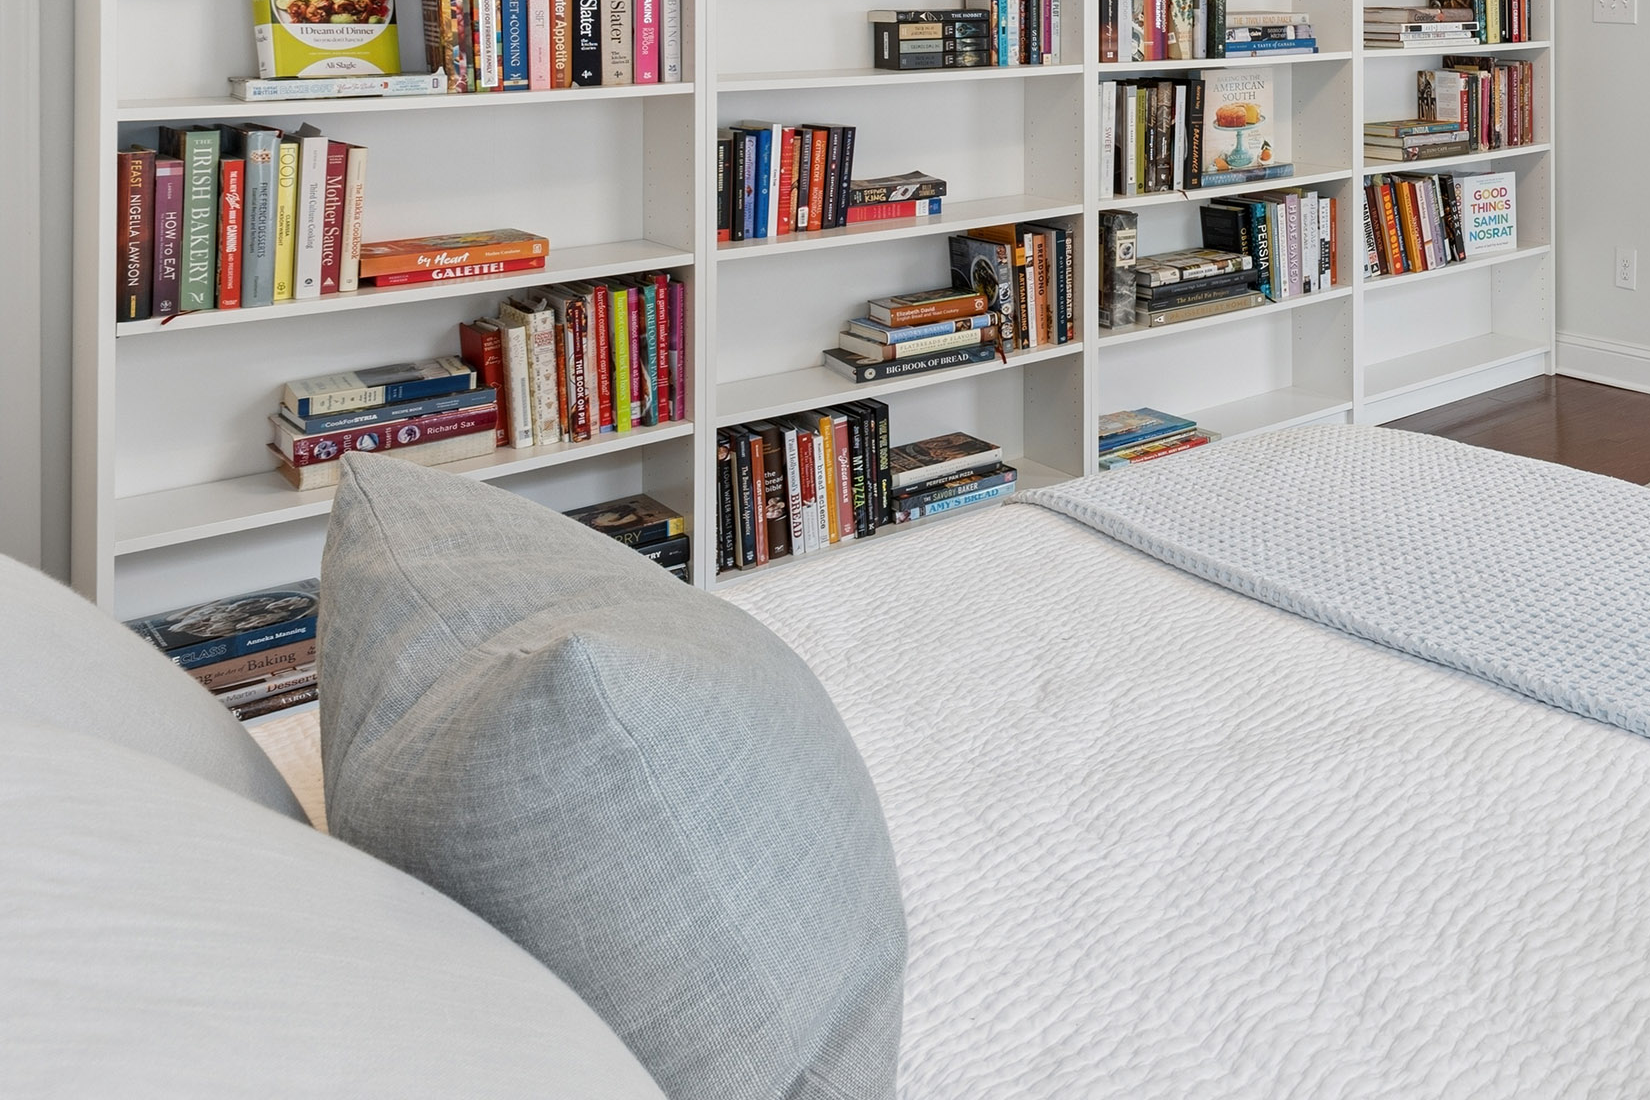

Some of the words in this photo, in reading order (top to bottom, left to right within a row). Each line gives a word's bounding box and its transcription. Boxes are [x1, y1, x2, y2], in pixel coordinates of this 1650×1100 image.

[609, 0, 627, 44] Slater
[1052, 2, 1060, 18] PLOT
[304, 26, 335, 36] Dream
[344, 26, 375, 36] Dinner
[509, 19, 522, 68] COOKING
[552, 20, 568, 70] Appetite
[335, 60, 357, 71] Slagle
[1212, 80, 1266, 94] AMERICAN
[1222, 91, 1257, 103] SOUTH
[1103, 126, 1112, 154] SWEET
[1191, 127, 1201, 173] BRILLIANCE
[130, 159, 143, 188] FEAST
[192, 146, 213, 200] IRISH
[279, 146, 296, 188] FOOD
[259, 182, 269, 198] FINE
[325, 175, 343, 225] Mother
[863, 187, 887, 195] STEPHEN
[864, 194, 887, 203] KING
[1454, 183, 1463, 207] GOOD
[1473, 187, 1508, 201] GOOD
[128, 194, 142, 238] NIGELLA
[258, 198, 268, 224] FRENCH
[353, 195, 363, 221] Hakka
[1383, 194, 1396, 227] DOBRE
[1470, 199, 1512, 215] THINGS
[165, 211, 177, 238] HOW
[1473, 213, 1509, 228] SAMIN
[188, 207, 212, 285] BAKERY
[257, 224, 267, 258] DESSERTS
[351, 221, 362, 260] Cookbook
[1364, 220, 1376, 254] HUNGRY
[1388, 228, 1401, 260] DOBRE
[1469, 225, 1514, 242] NOSRAT
[164, 242, 173, 256] TO
[322, 227, 340, 266] Sauce
[417, 255, 431, 267] by
[434, 251, 470, 265] Heart
[1065, 237, 1073, 265] BREAD
[1257, 223, 1270, 271] PERSIA
[127, 241, 140, 287] LAWSON
[163, 258, 176, 280] EAT
[431, 261, 505, 280] GALETTE!
[1037, 243, 1045, 296] BREADSONG
[1289, 243, 1300, 284] BAKED
[1018, 272, 1027, 303] ARTISAN
[1065, 266, 1073, 319] ILLUSTRATED
[596, 290, 606, 318] barefoot
[896, 308, 921, 317] Elizabeth
[921, 306, 936, 314] David
[1225, 300, 1248, 311] HOME
[1020, 304, 1028, 332] BAKING
[575, 359, 584, 375] THE
[886, 364, 901, 375] BIG
[902, 361, 928, 373] BOOK
[928, 358, 940, 368] OF
[940, 353, 970, 366] BREAD
[576, 375, 585, 399] BOOK
[577, 399, 586, 412] ON
[427, 424, 458, 436] Richard
[460, 420, 476, 430] Sax
[577, 412, 587, 426] PIE
[764, 470, 777, 478] the
[852, 455, 864, 471] MY
[764, 475, 784, 486] bread
[765, 483, 783, 494] bible
[816, 464, 825, 491] bread
[926, 477, 949, 487] PERFECT
[948, 474, 960, 482] PAN
[959, 470, 975, 479] PIZZA
[853, 475, 866, 509] PIZZA
[928, 498, 962, 514] AMY'S
[964, 488, 999, 503] BREAD
[932, 489, 957, 502] SAVORY
[957, 483, 979, 495] BAKER
[790, 493, 804, 539] BREAD
[817, 494, 827, 530] science
[246, 634, 274, 647] Anneka
[275, 626, 307, 640] Manning
[246, 652, 297, 672] Baking
[279, 690, 313, 706] AARON
